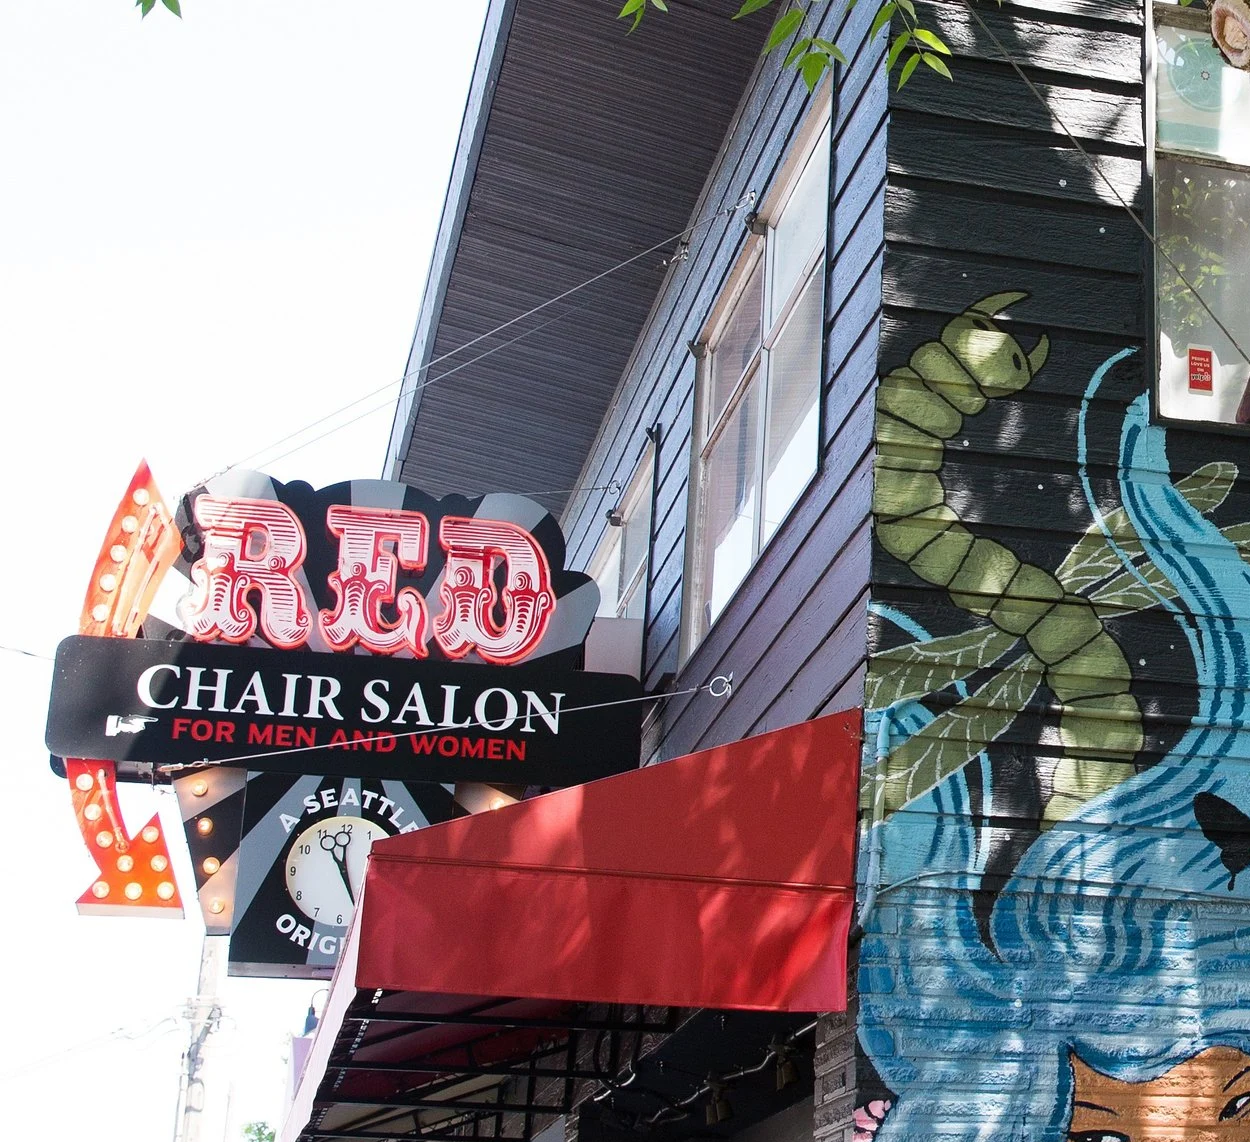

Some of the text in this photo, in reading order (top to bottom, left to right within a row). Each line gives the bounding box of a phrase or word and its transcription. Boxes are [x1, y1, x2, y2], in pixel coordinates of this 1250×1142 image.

[186, 493, 558, 667] RED
[137, 663, 567, 735] CHAIR SALON
[171, 717, 527, 762] FOR MEN AND WOMEN
[279, 812, 301, 834] A
[367, 831, 372, 840] 1
[299, 844, 311, 855] 10
[290, 866, 297, 877] 9
[296, 890, 303, 902] 8
[313, 907, 321, 918] 7
[336, 914, 343, 925] 6
